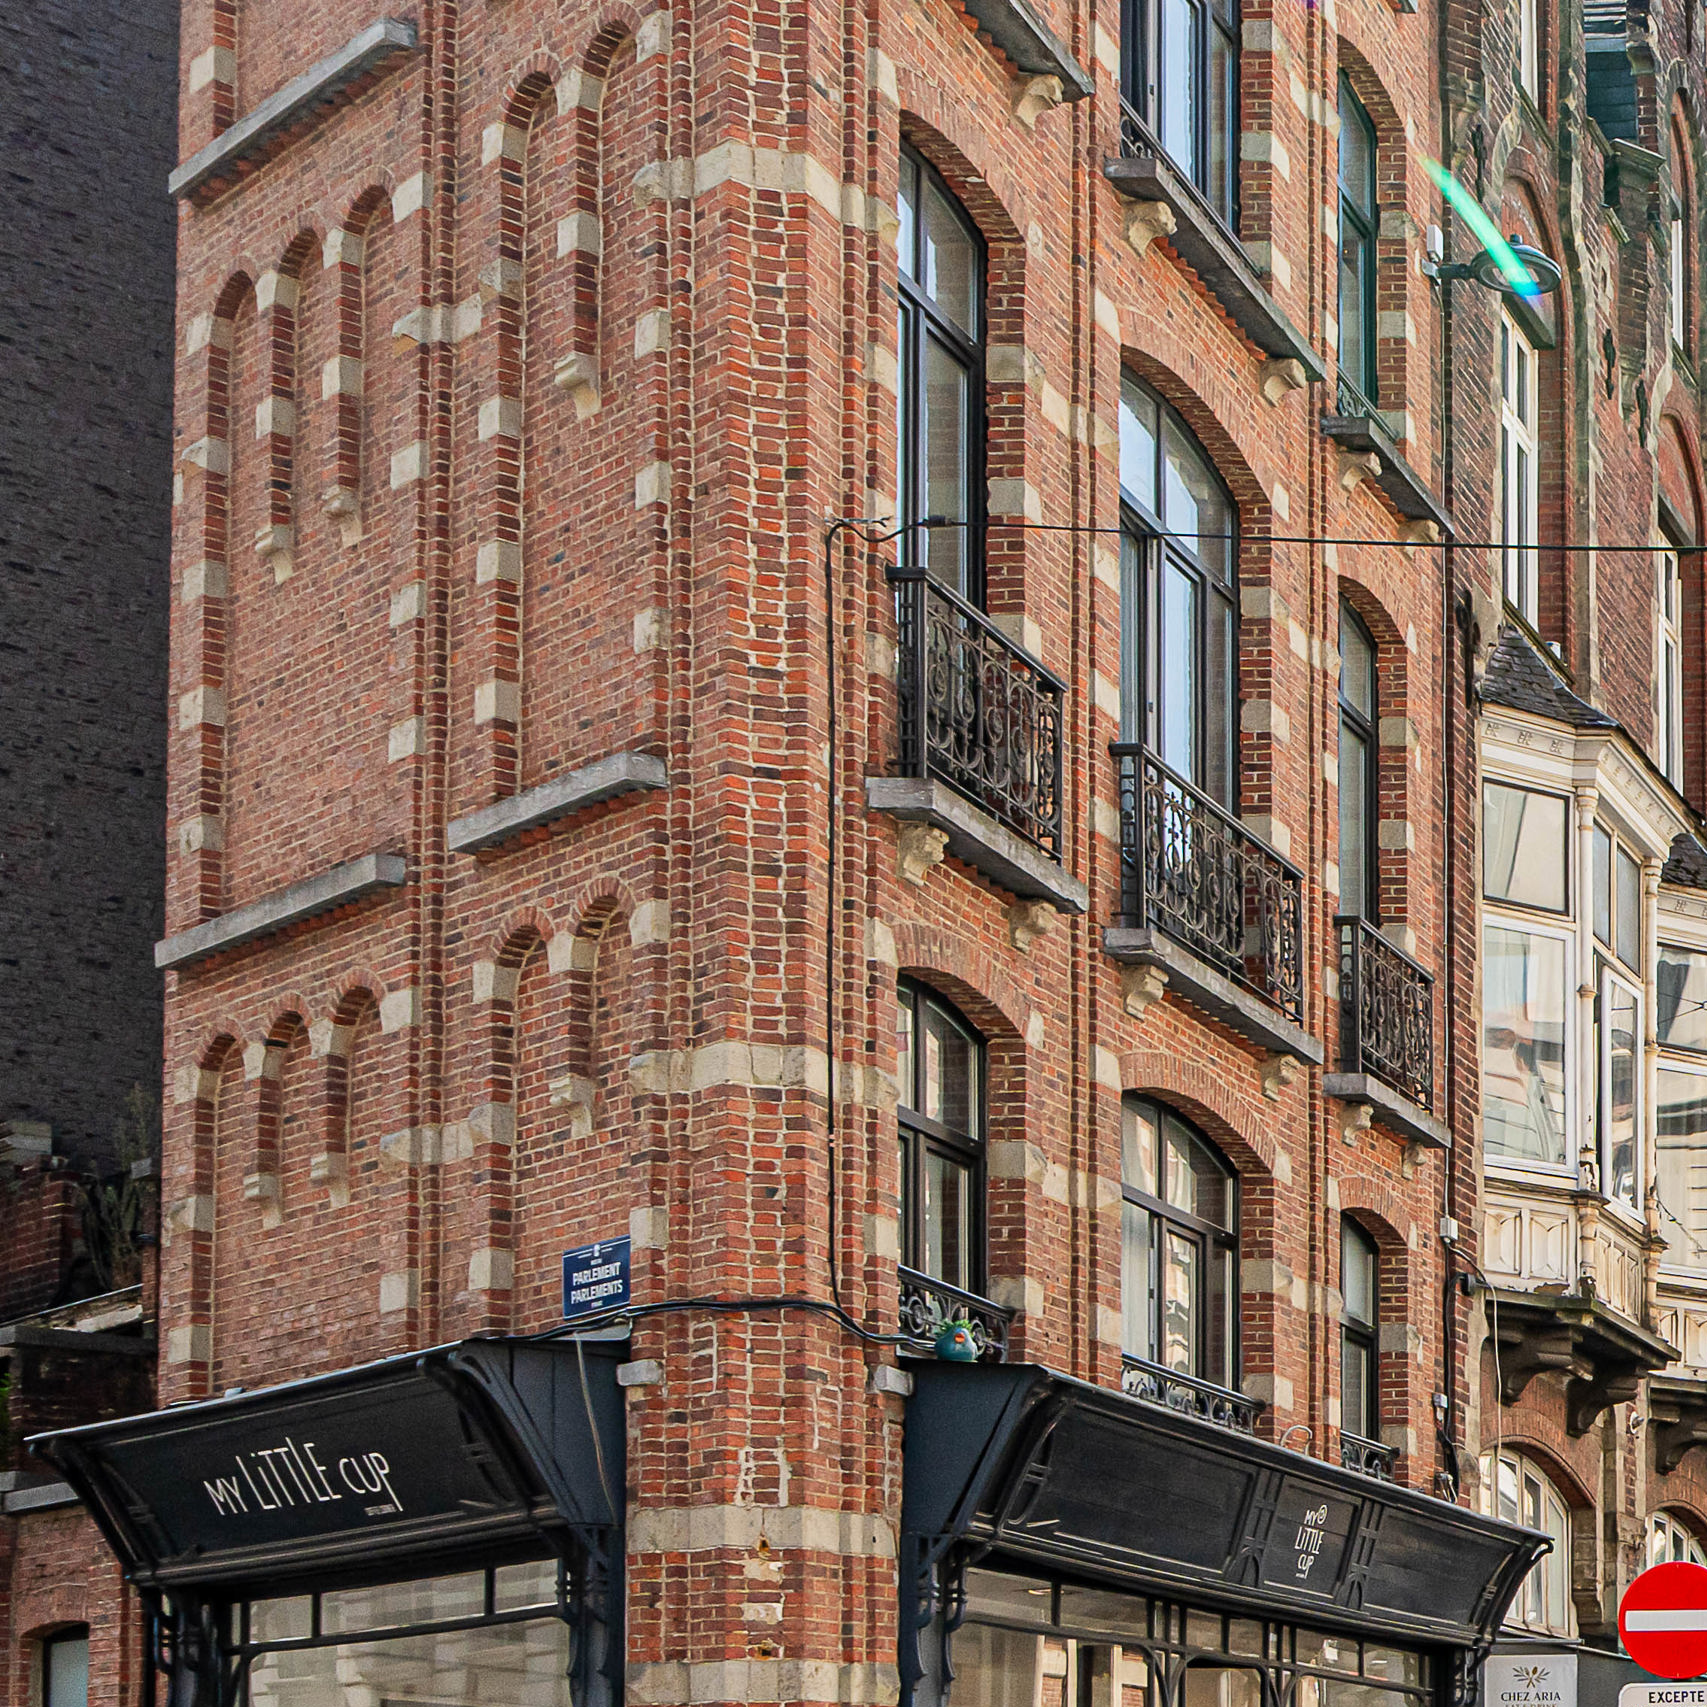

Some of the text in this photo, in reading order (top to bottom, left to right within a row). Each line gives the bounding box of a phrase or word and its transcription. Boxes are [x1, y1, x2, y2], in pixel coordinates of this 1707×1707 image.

[572, 1261, 622, 1287] PARLEMENT
[571, 1279, 623, 1304] PARLEMENTS
[203, 1475, 249, 1516] MY
[339, 1452, 404, 1512] CUP
[1298, 1553, 1315, 1579] CUP
[1500, 1691, 1562, 1702] CHEZ ARIA
[1648, 1690, 1705, 1704] EXCEPTE
